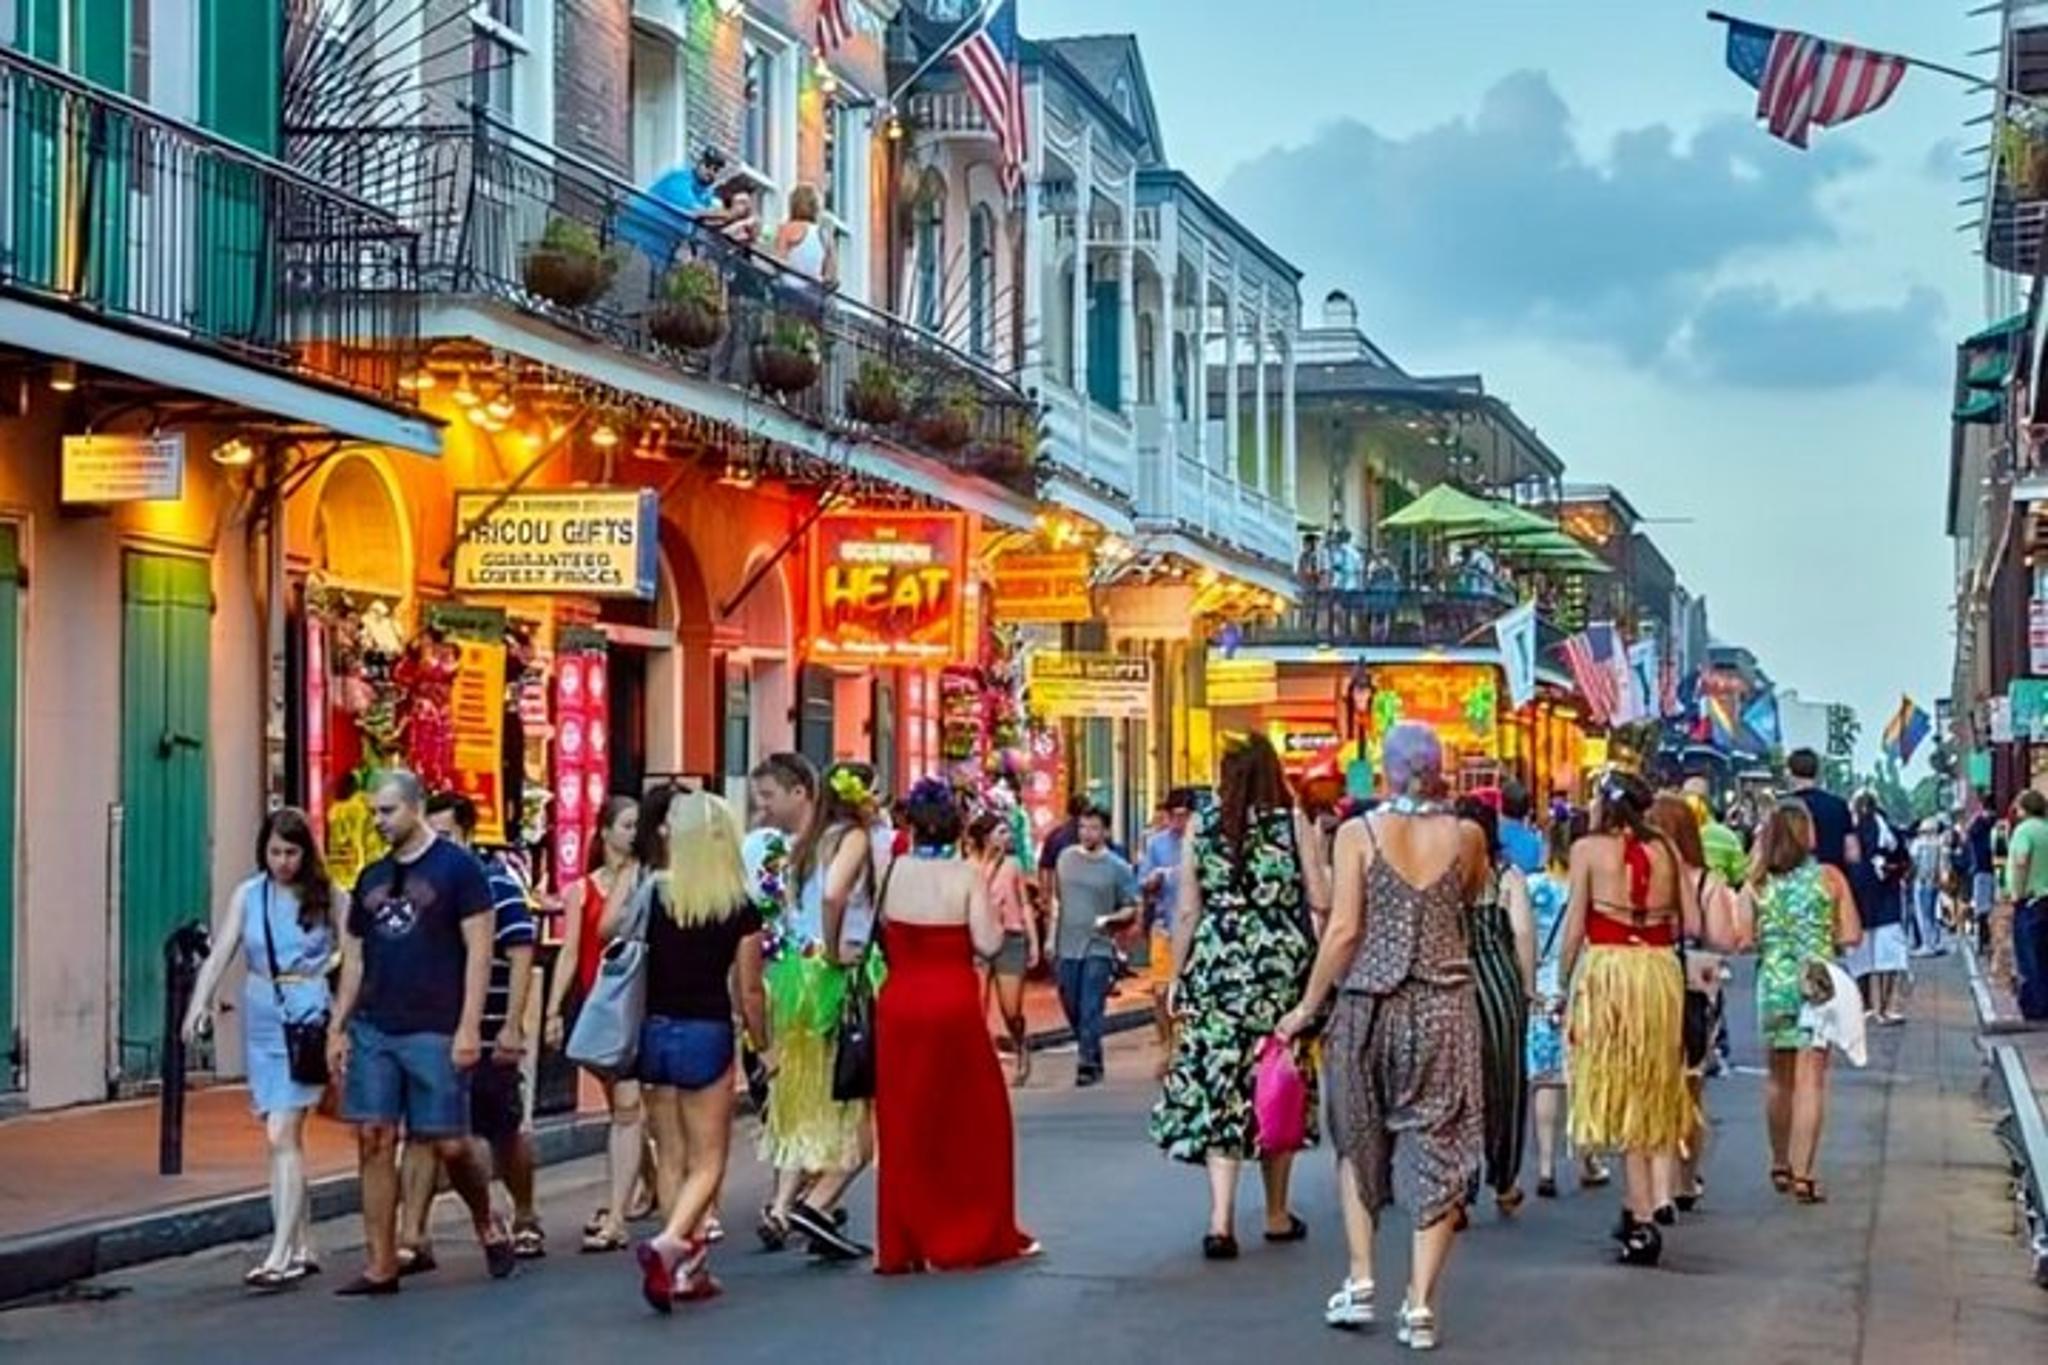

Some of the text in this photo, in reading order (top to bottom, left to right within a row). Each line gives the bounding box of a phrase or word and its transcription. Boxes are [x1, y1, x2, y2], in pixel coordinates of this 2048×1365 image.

[562, 518, 634, 545] GIFTS
[480, 551, 611, 567] GUARANTEED
[468, 569, 623, 586] LOWEST PRICES
[825, 565, 949, 612] HEAT
